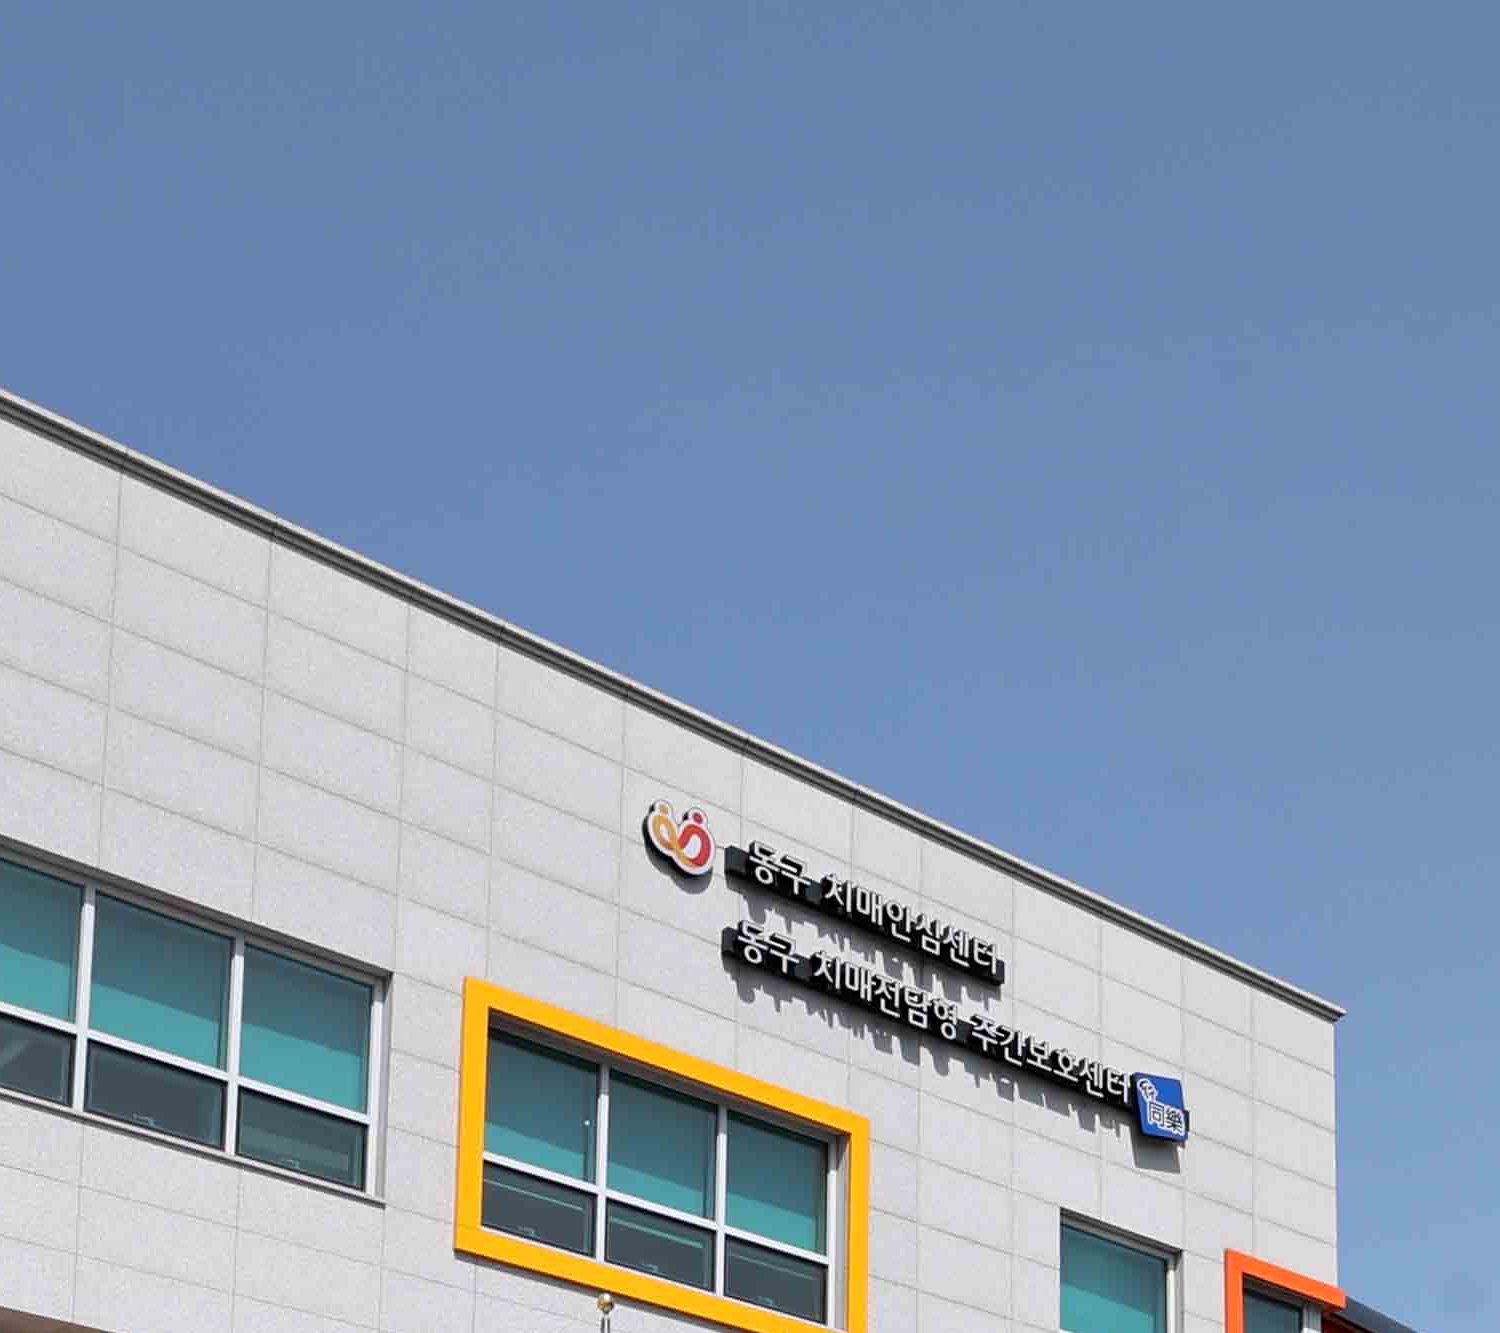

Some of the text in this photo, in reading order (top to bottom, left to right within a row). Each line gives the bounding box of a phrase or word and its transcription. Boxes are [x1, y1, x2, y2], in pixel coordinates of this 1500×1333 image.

[750, 840, 998, 975] 동구 치매안심센터
[737, 919, 1130, 1104] 동구 치매전담형 주간보호센터
